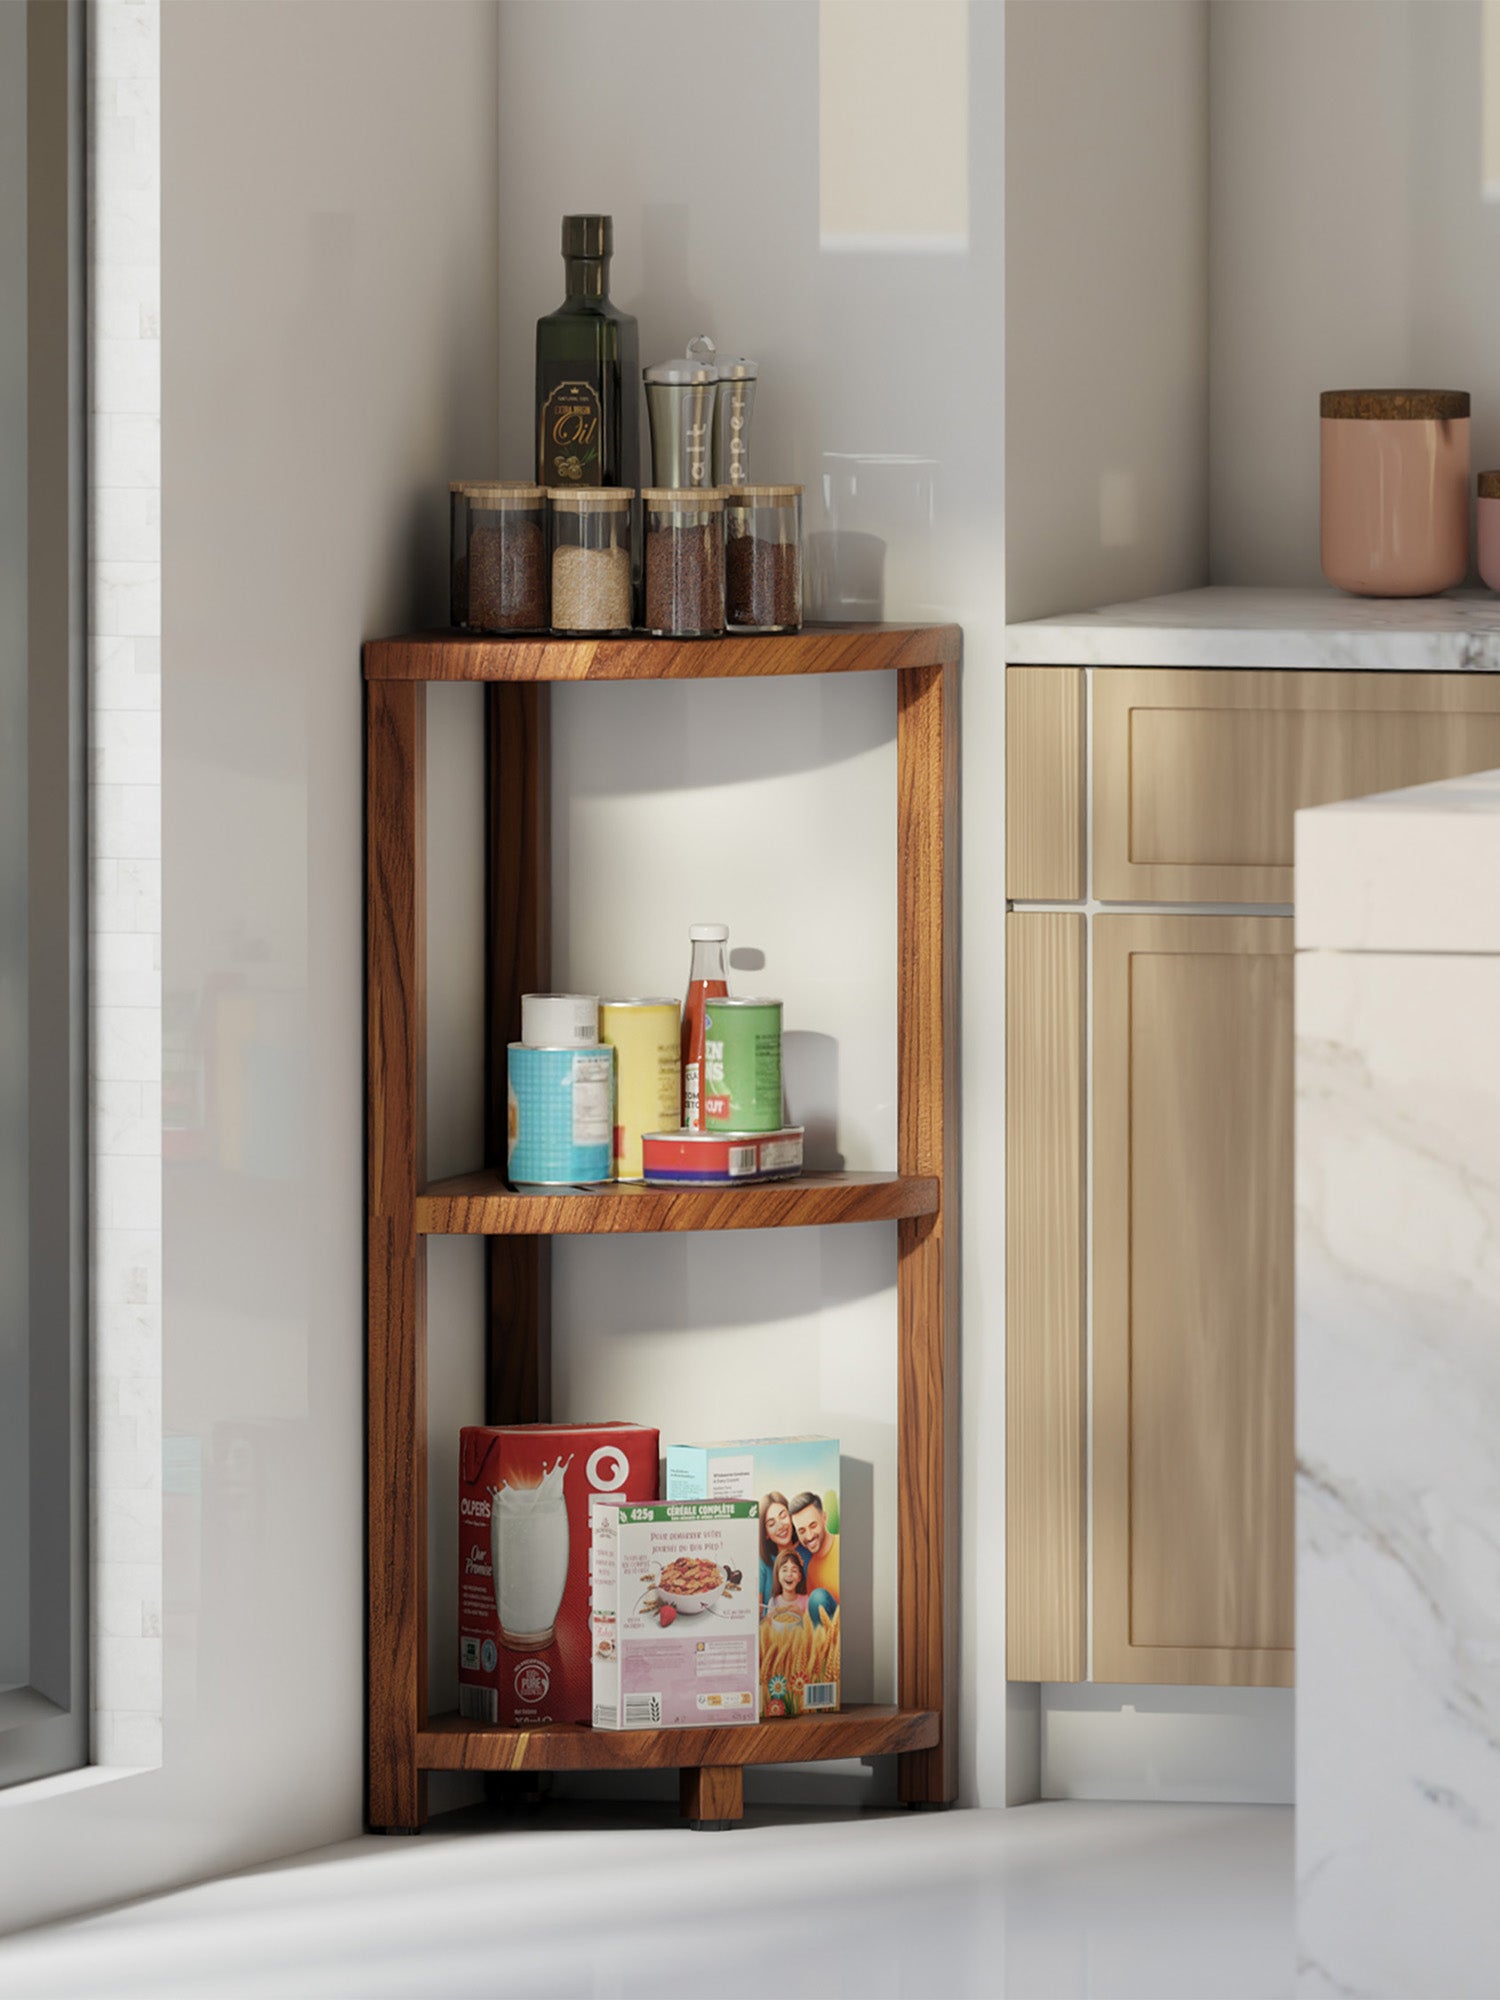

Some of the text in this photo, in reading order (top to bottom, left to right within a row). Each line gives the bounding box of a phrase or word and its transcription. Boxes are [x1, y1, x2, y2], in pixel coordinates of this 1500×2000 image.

[552, 411, 597, 445] Oil
[461, 1498, 491, 1518] OLPER'S
[630, 1508, 654, 1521] 425g
